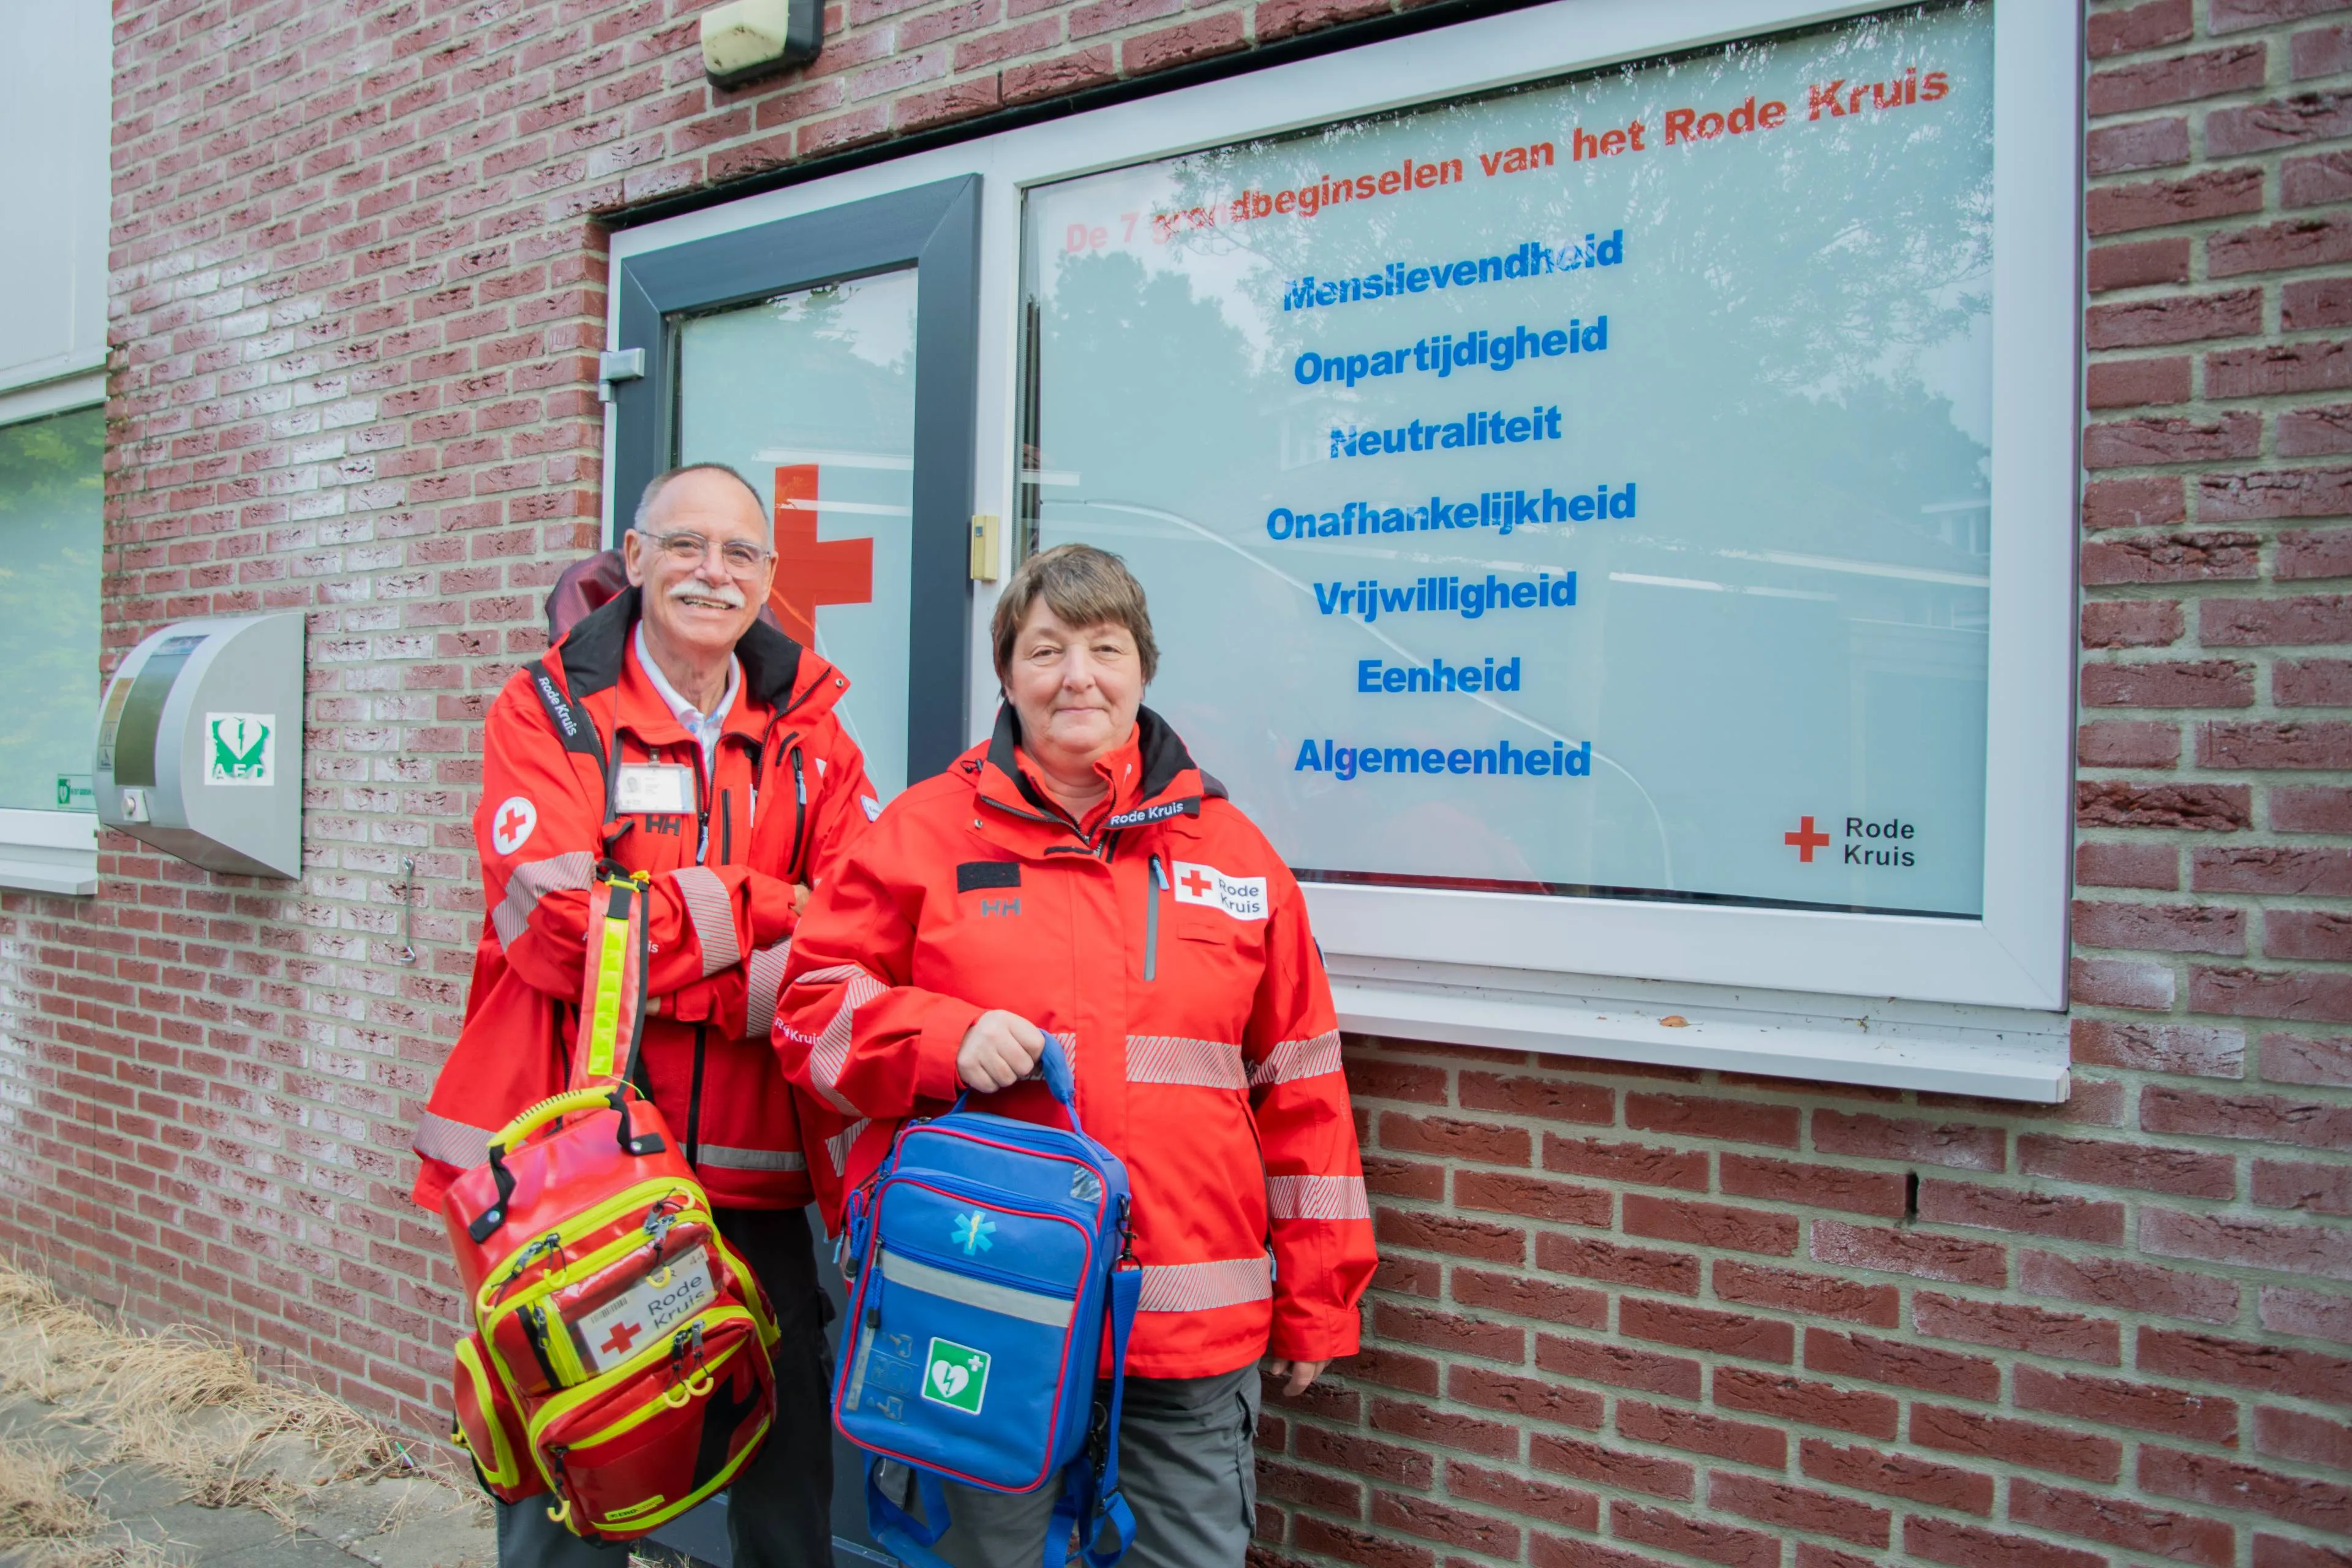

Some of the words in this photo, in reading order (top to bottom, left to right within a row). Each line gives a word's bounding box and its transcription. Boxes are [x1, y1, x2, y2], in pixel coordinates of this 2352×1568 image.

[1066, 223, 1107, 254] De
[1120, 212, 1140, 243] 7
[1152, 158, 1463, 244] grondbeginselen
[1479, 141, 1555, 177] van
[1572, 119, 1646, 162] het
[1664, 95, 1787, 146] Rode
[1808, 67, 1950, 121] Kruis
[1284, 228, 1623, 312] Menslievendheid
[1294, 315, 1608, 388] Onpartijdigheid
[1330, 405, 1562, 459] Neutraliteit
[1267, 483, 1636, 540] Onafhankelijkheid
[1313, 571, 1577, 623] Vrijwilligheid
[1358, 657, 1520, 693] Eenheid
[538, 677, 560, 705] Rode
[554, 704, 577, 736] Kruis
[213, 763, 266, 779] AED
[1294, 739, 1591, 781] Algemeenheid
[1110, 810, 1145, 826] Rode
[1148, 802, 1183, 819] Kruis
[1846, 816, 1915, 839] Rode
[1844, 844, 1915, 867] Kruis
[1219, 878, 1259, 897] Rode
[1221, 892, 1261, 913] Kruis
[647, 1276, 703, 1316] Rode
[654, 1290, 706, 1330] Kruis
